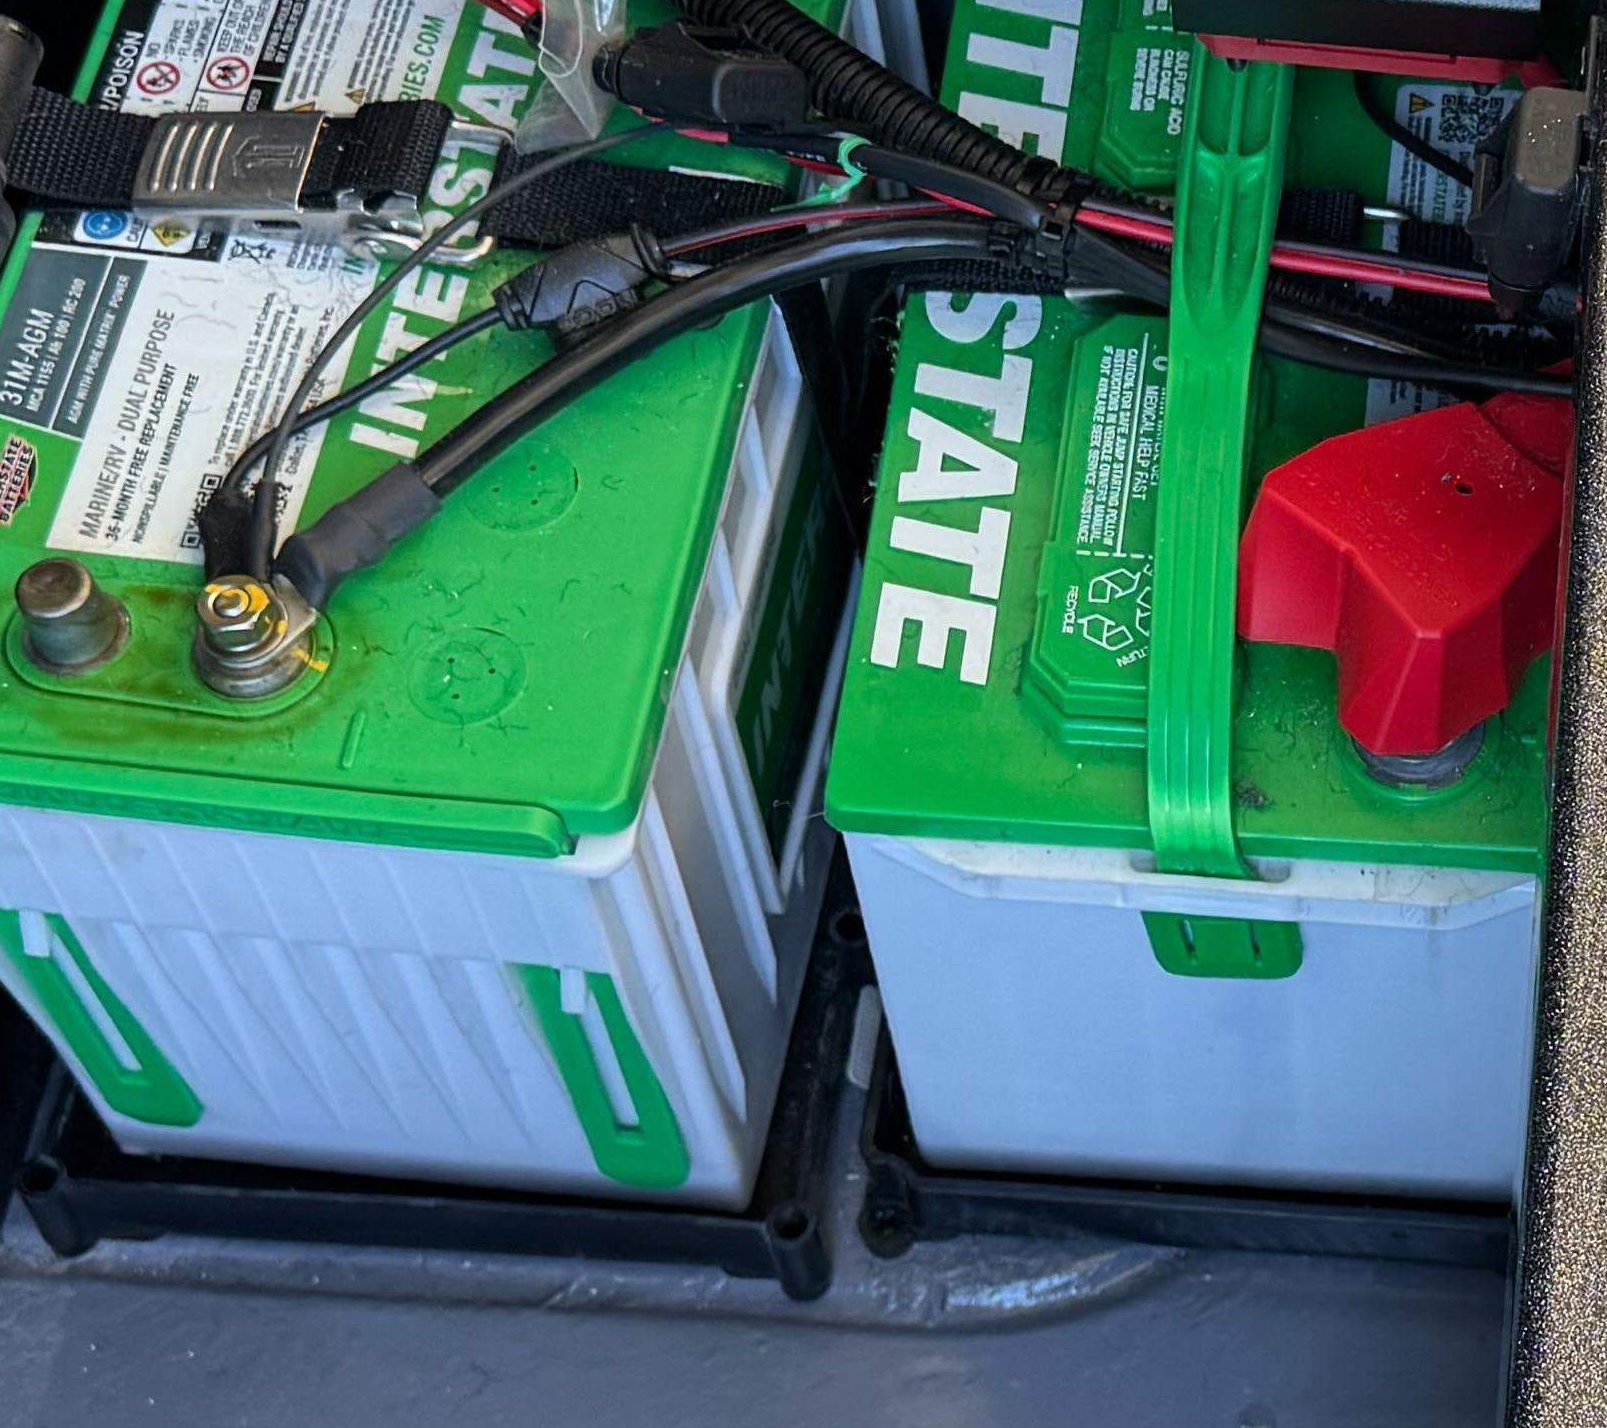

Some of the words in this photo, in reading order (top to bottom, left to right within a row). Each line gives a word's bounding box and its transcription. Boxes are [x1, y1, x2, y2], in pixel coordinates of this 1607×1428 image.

[145, 43, 161, 57] NO
[25, 387, 44, 411] MCA
[67, 400, 83, 422] AGM
[75, 374, 93, 400] WITH
[181, 372, 199, 396] FREE
[1120, 390, 1133, 408] FOR
[78, 444, 125, 538] MARINE/RV
[116, 389, 147, 431] DUAL
[132, 309, 174, 385] PURPOSE
[1116, 410, 1130, 433] SAFE
[1139, 385, 1159, 433] MEDICAL
[1089, 424, 1102, 446] SEEK
[104, 479, 136, 540] 36-MONTH
[127, 448, 149, 477] FREE
[138, 363, 175, 446] REPLACEMENT
[1084, 449, 1099, 485] SERVICE
[1136, 438, 1152, 466] HELP
[1108, 462, 1123, 506] STARTING
[1131, 471, 1148, 500] FAST
[1102, 508, 1117, 545] FOLLOW
[1062, 583, 1081, 636] RECYCLE
